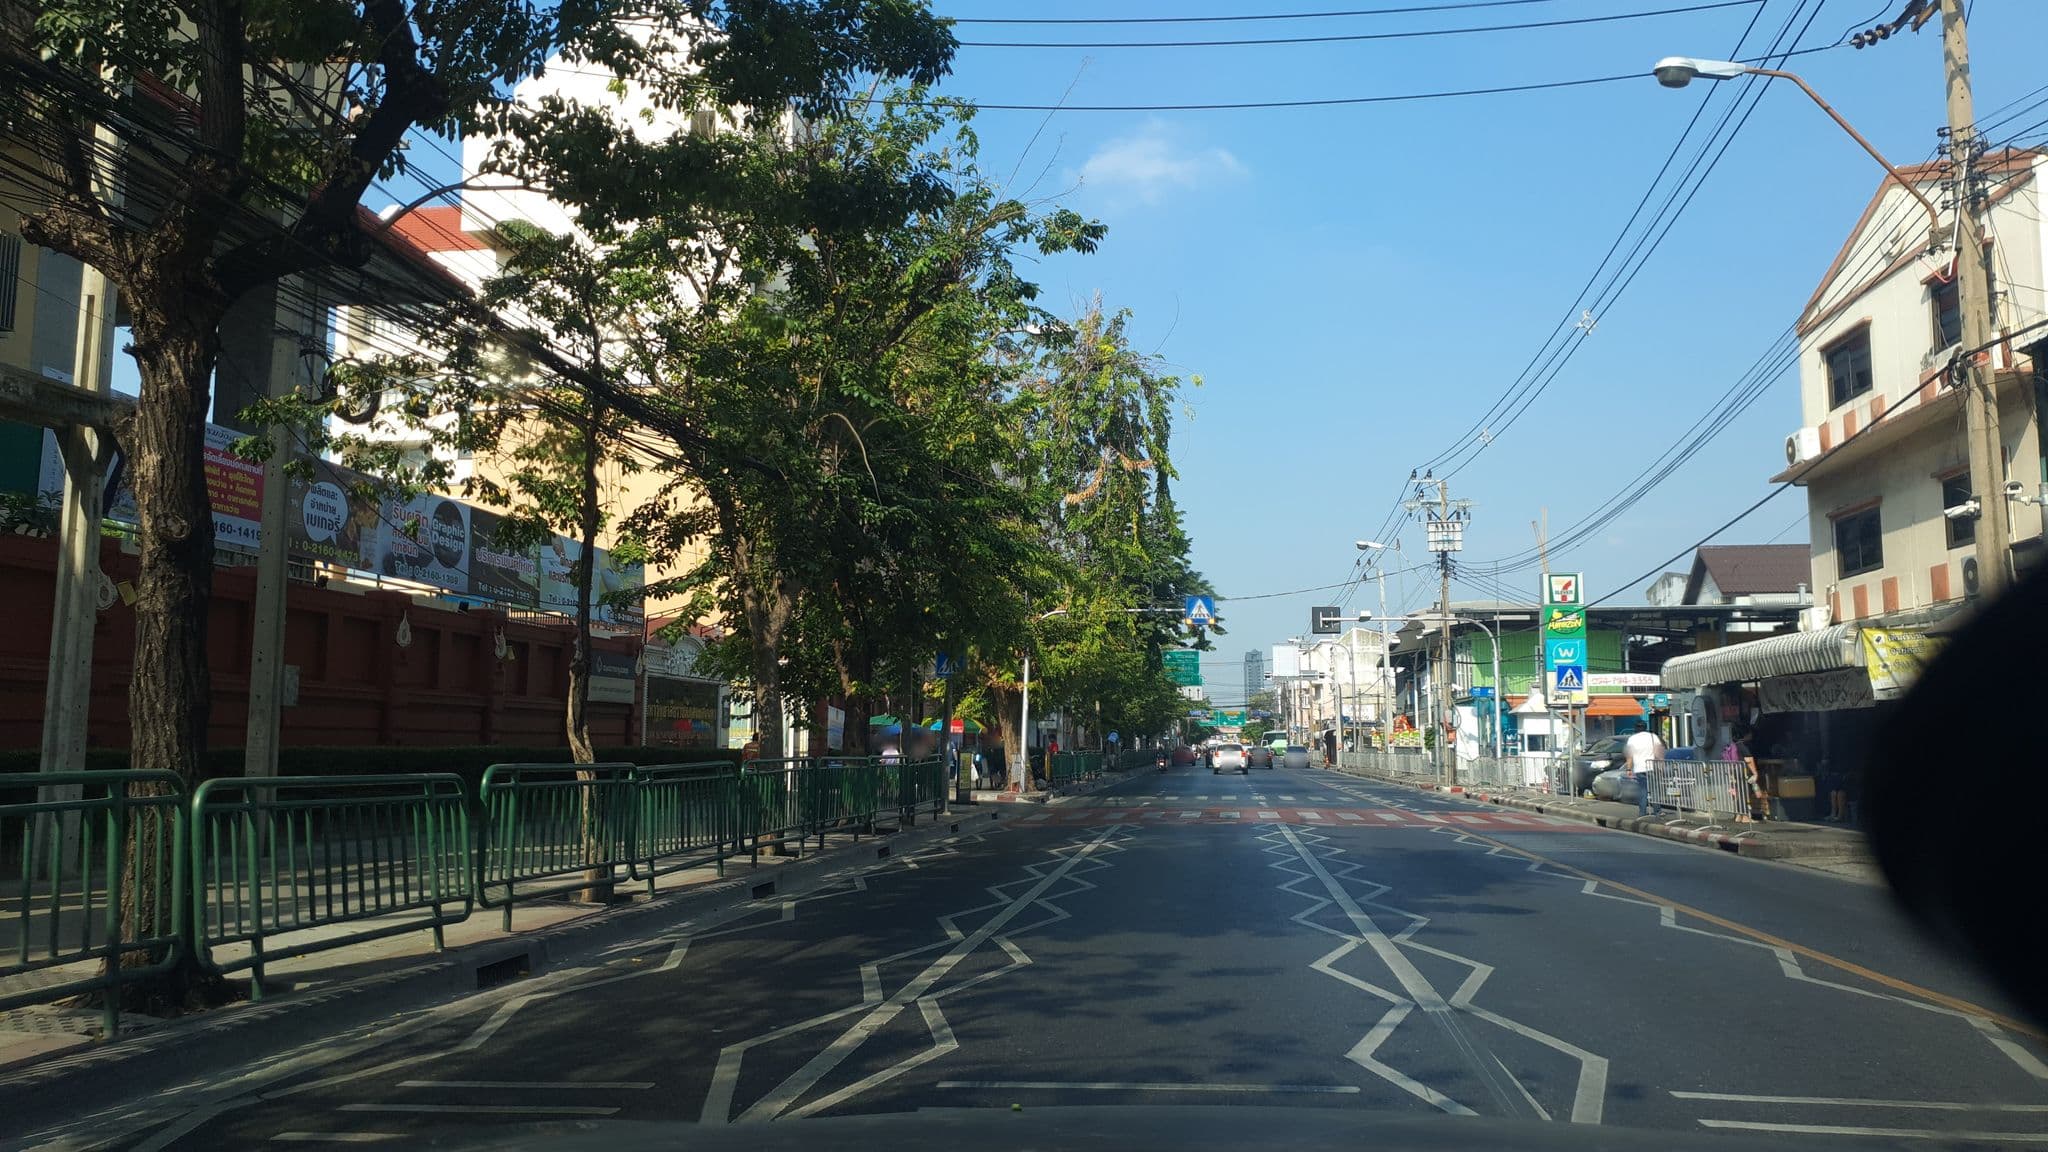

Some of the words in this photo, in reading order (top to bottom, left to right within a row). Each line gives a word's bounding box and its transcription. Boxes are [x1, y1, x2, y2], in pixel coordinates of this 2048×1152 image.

[310, 484, 338, 501] ผลิตและ
[310, 497, 337, 515] จำหน่าย
[306, 513, 341, 533] เบเกอรี่
[432, 518, 465, 539] Graphic
[431, 530, 464, 552] Design
